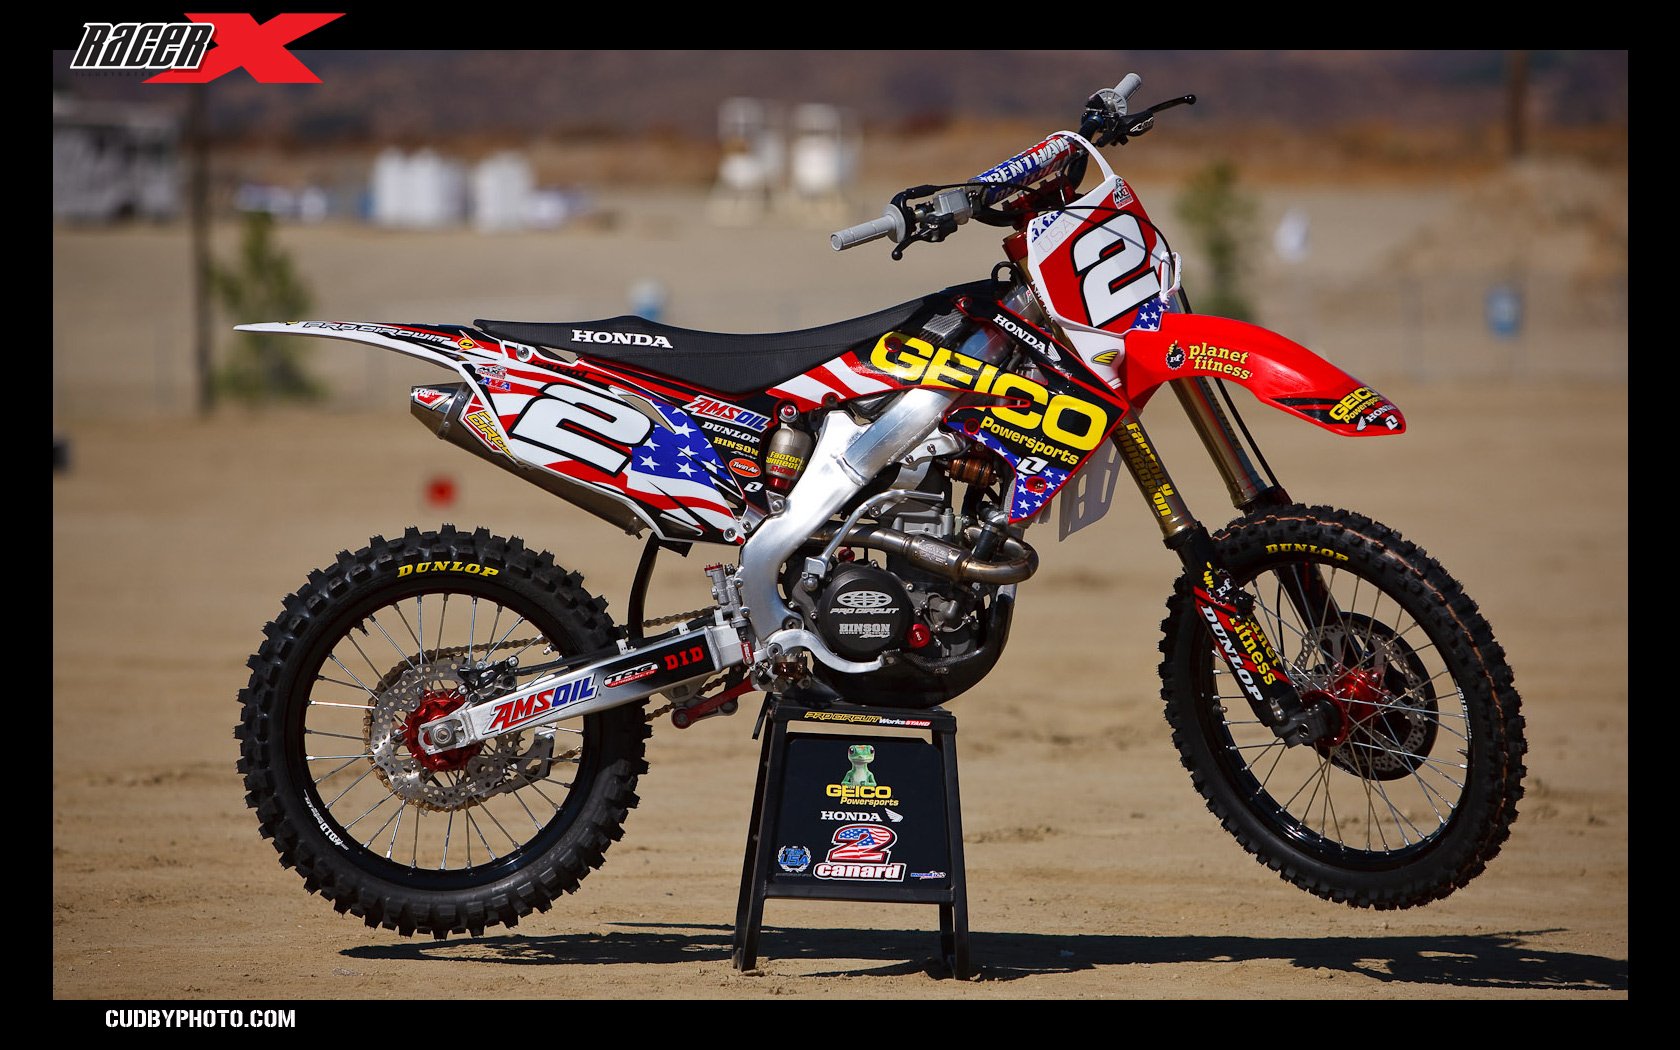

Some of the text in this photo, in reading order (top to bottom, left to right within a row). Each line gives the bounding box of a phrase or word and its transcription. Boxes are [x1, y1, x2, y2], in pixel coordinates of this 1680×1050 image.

[1037, 219, 1075, 252] USA
[1070, 212, 1162, 329] 2
[571, 330, 673, 348] HONDA
[993, 314, 1046, 354] HONDA
[1188, 342, 1250, 365] planet
[1193, 356, 1251, 380] fitness
[869, 331, 1108, 451] GEICO
[688, 397, 769, 431] AMSOIL
[507, 382, 652, 476] 2
[702, 421, 761, 444] DUNLOP
[713, 436, 759, 457] HINSON
[979, 416, 1079, 466] Powersports
[733, 461, 759, 474] Twin Air
[1265, 543, 1349, 562] DUNLOP
[397, 560, 499, 578] DUNLOP
[830, 607, 900, 615] PRO CIRCUIT
[839, 624, 891, 633] HINSON
[1200, 605, 1264, 701] DUNLOP
[488, 675, 597, 731] AMSOIL
[804, 711, 833, 720] PRO
[832, 713, 882, 723] CIRCUIT
[826, 784, 892, 799] GEICO
[840, 797, 899, 808] Powersports
[820, 810, 882, 822] HONDA
[828, 824, 898, 864] 2
[780, 854, 809, 866] USA
[815, 863, 903, 880] canard
